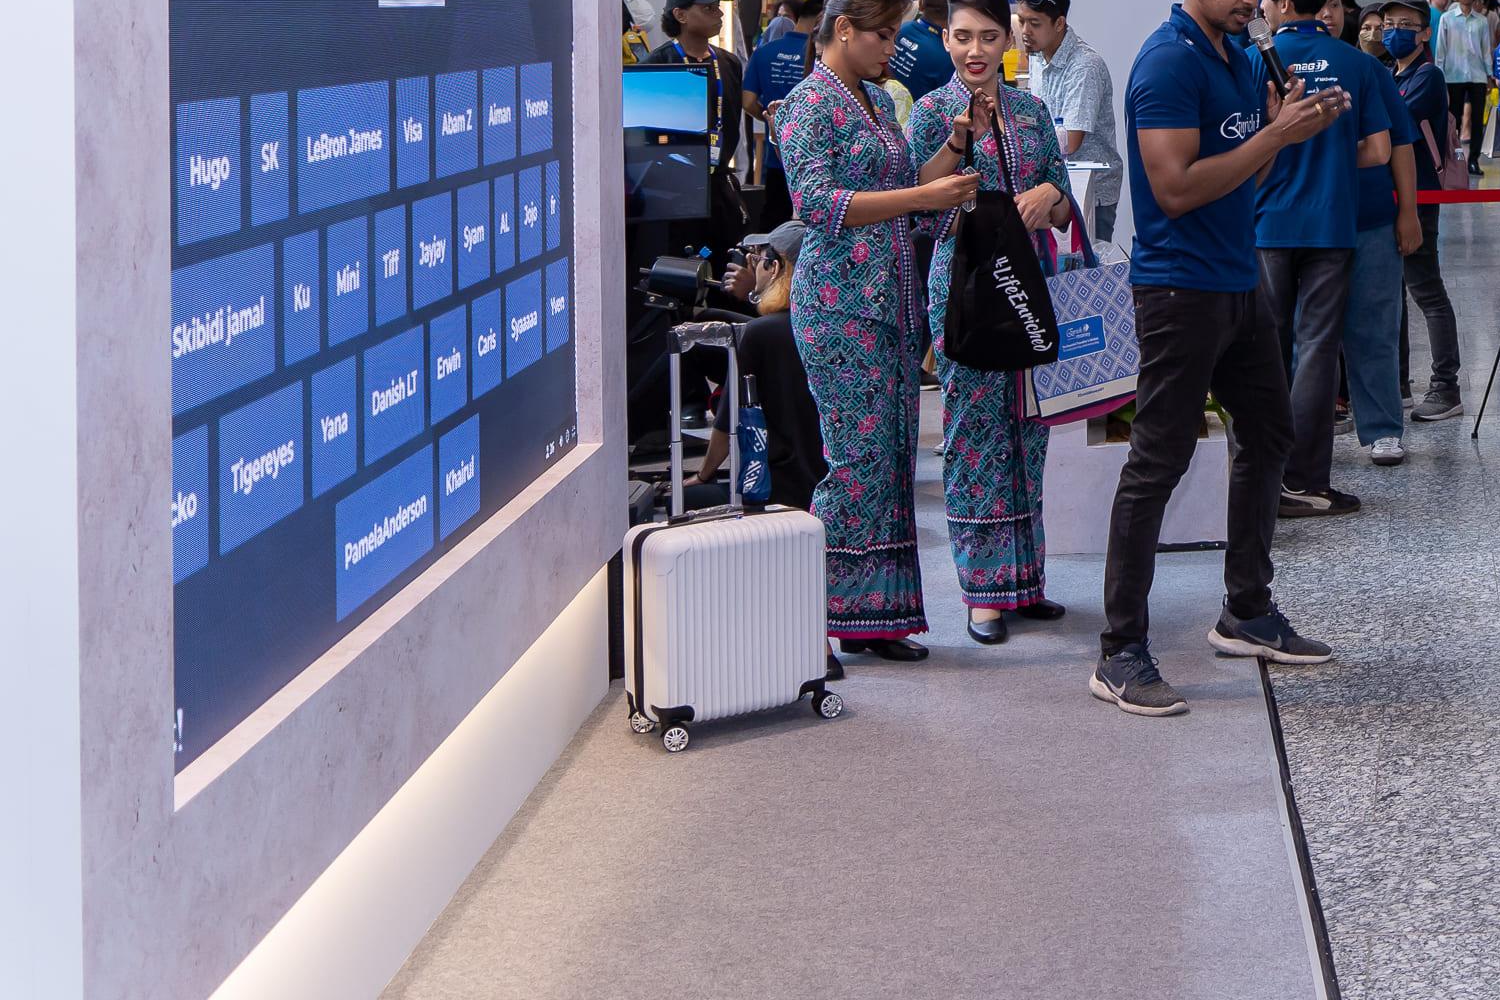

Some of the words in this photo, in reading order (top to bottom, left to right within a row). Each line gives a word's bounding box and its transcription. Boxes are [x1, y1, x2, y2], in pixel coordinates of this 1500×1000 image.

[441, 111, 466, 137] Abam
[466, 108, 473, 132] Z
[487, 102, 512, 127] Aiman
[525, 98, 549, 119] Yvonne
[306, 131, 347, 164] LeBron
[348, 125, 383, 155] James
[403, 119, 423, 144] Visa
[189, 154, 231, 190] Hugo
[261, 141, 280, 174] SK
[500, 212, 510, 235] AL
[523, 201, 539, 228] Jojo
[419, 235, 447, 267] Jayjay
[463, 222, 485, 249] Syam
[336, 264, 360, 297] Mini
[382, 248, 400, 281] Tiff
[294, 283, 311, 314] Ku
[992, 255, 1053, 353] #LifeEnriched
[172, 307, 225, 359] Skibidi
[225, 296, 265, 346] jamal
[477, 328, 497, 358] Caris
[436, 350, 461, 380] Erwin
[371, 375, 405, 416] Danish
[406, 369, 418, 396] LT
[320, 411, 348, 443] Yana
[230, 439, 295, 495] Tigereyes
[445, 455, 475, 497] Khairul
[344, 494, 427, 571] PamelaAnderson
